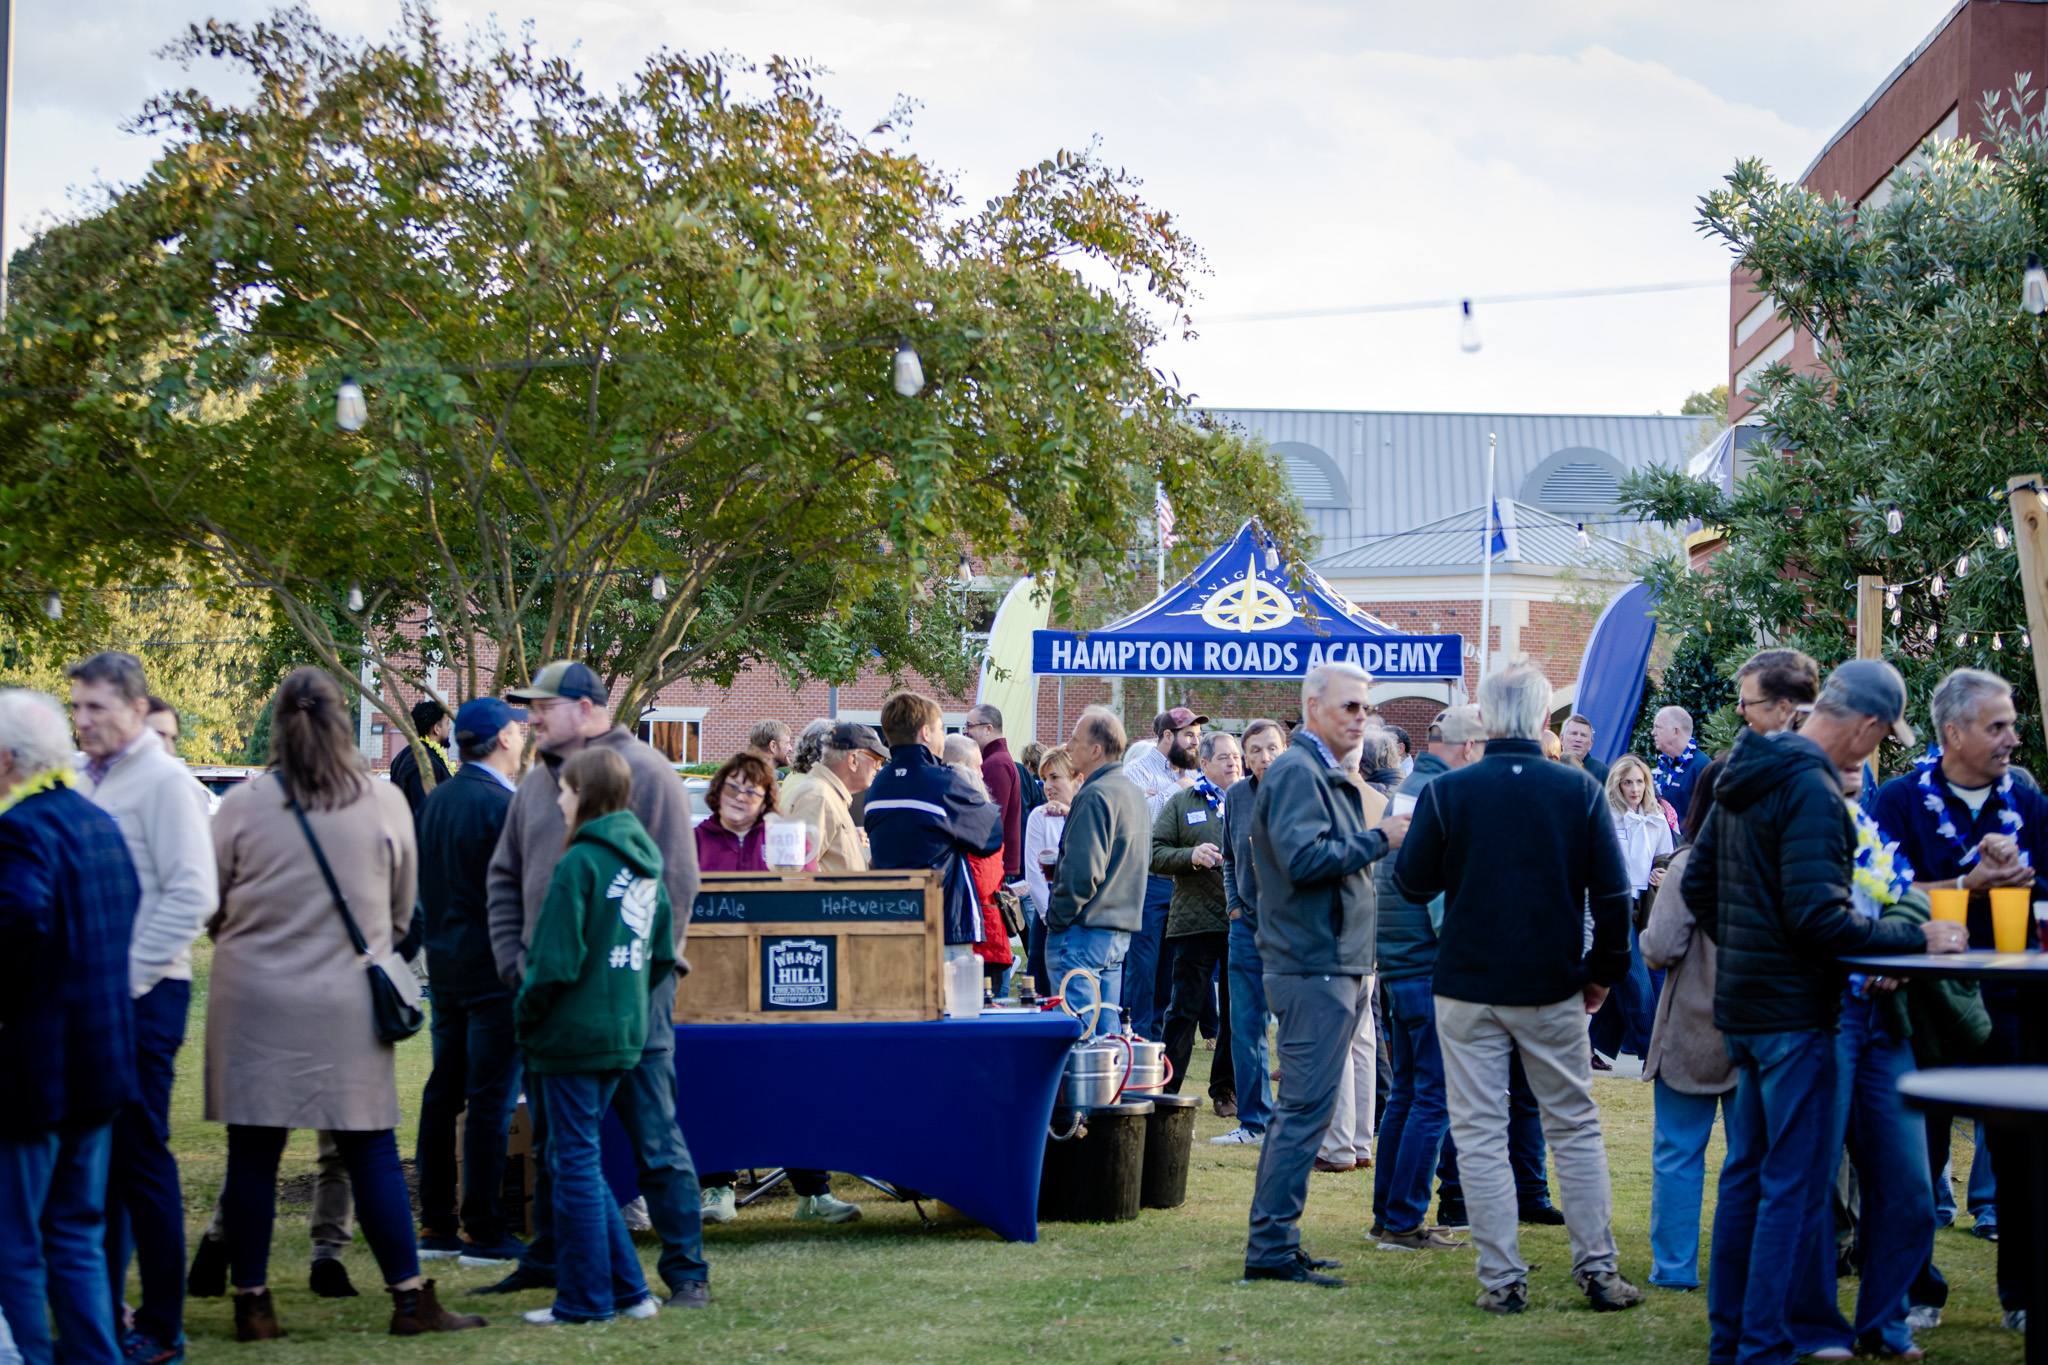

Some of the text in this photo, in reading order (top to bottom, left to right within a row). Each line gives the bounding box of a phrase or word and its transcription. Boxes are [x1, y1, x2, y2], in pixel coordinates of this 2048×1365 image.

[1052, 640, 1443, 673] HAMPTON ROADS ACADEMY
[716, 897, 746, 919] Ale
[821, 896, 920, 915] Hefeweizen
[774, 951, 822, 968] WHARF
[778, 967, 821, 984] HILL
